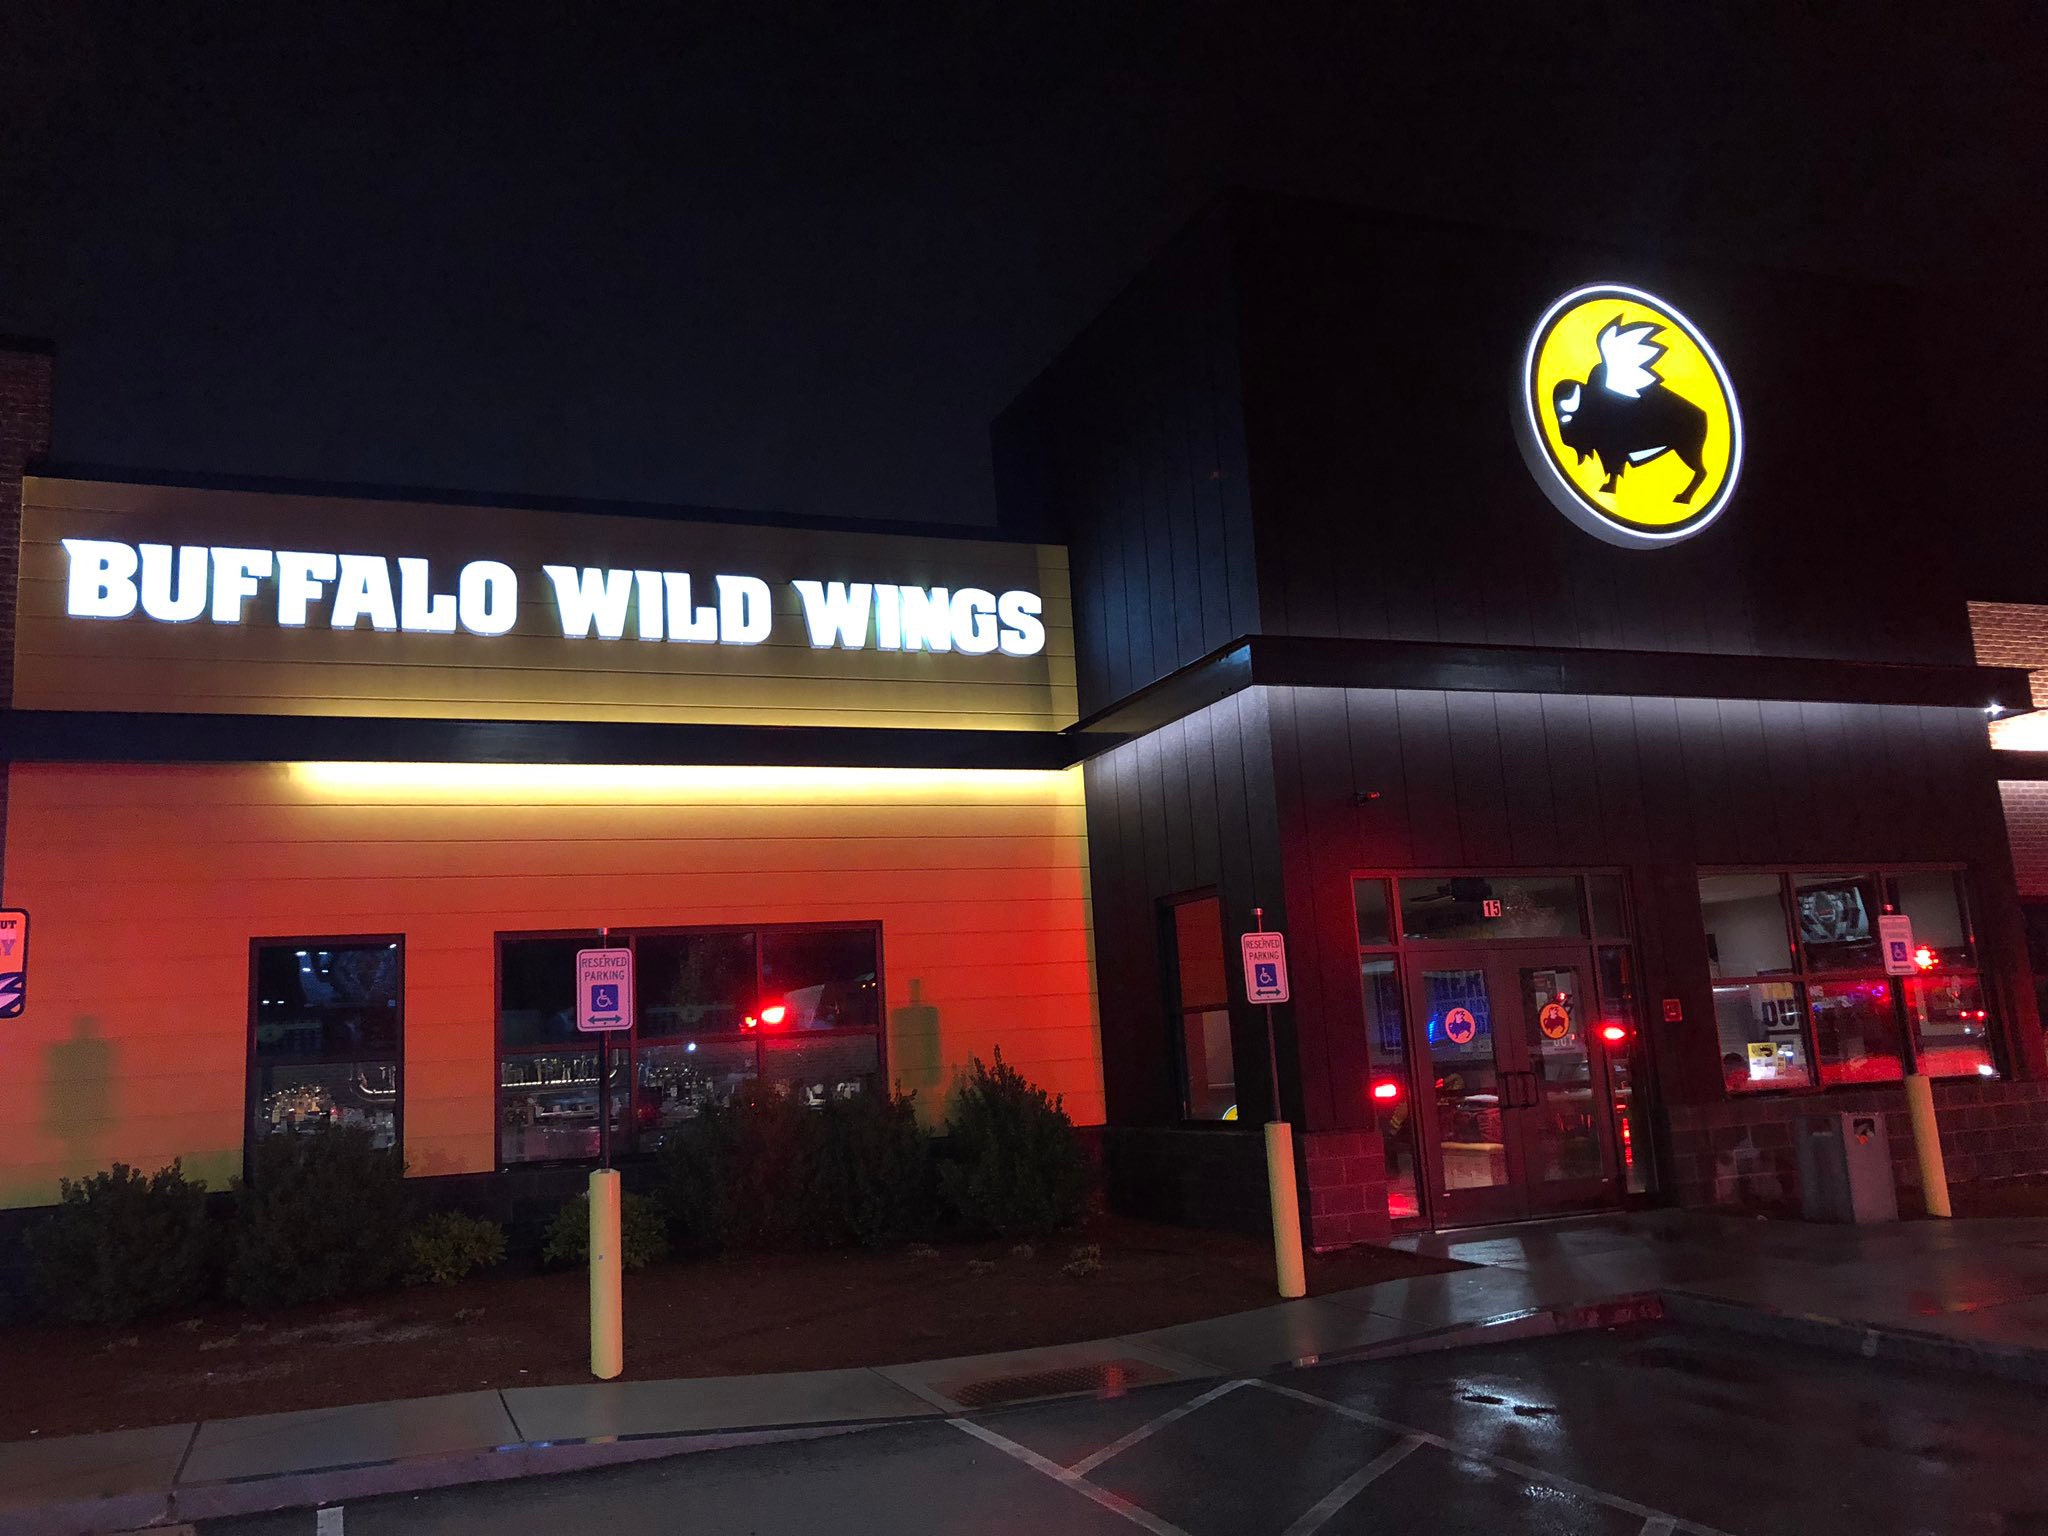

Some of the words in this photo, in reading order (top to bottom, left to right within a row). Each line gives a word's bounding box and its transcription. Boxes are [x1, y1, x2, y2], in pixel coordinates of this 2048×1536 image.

[62, 538, 518, 637] BUFFALO
[543, 564, 772, 646] WILD
[790, 578, 1046, 658] WINGS
[1485, 901, 1500, 916] 15
[1246, 940, 1280, 949] RESERVED
[1249, 951, 1279, 960] PARKING
[582, 957, 627, 968] RESERVED
[585, 971, 625, 981] PARKING
